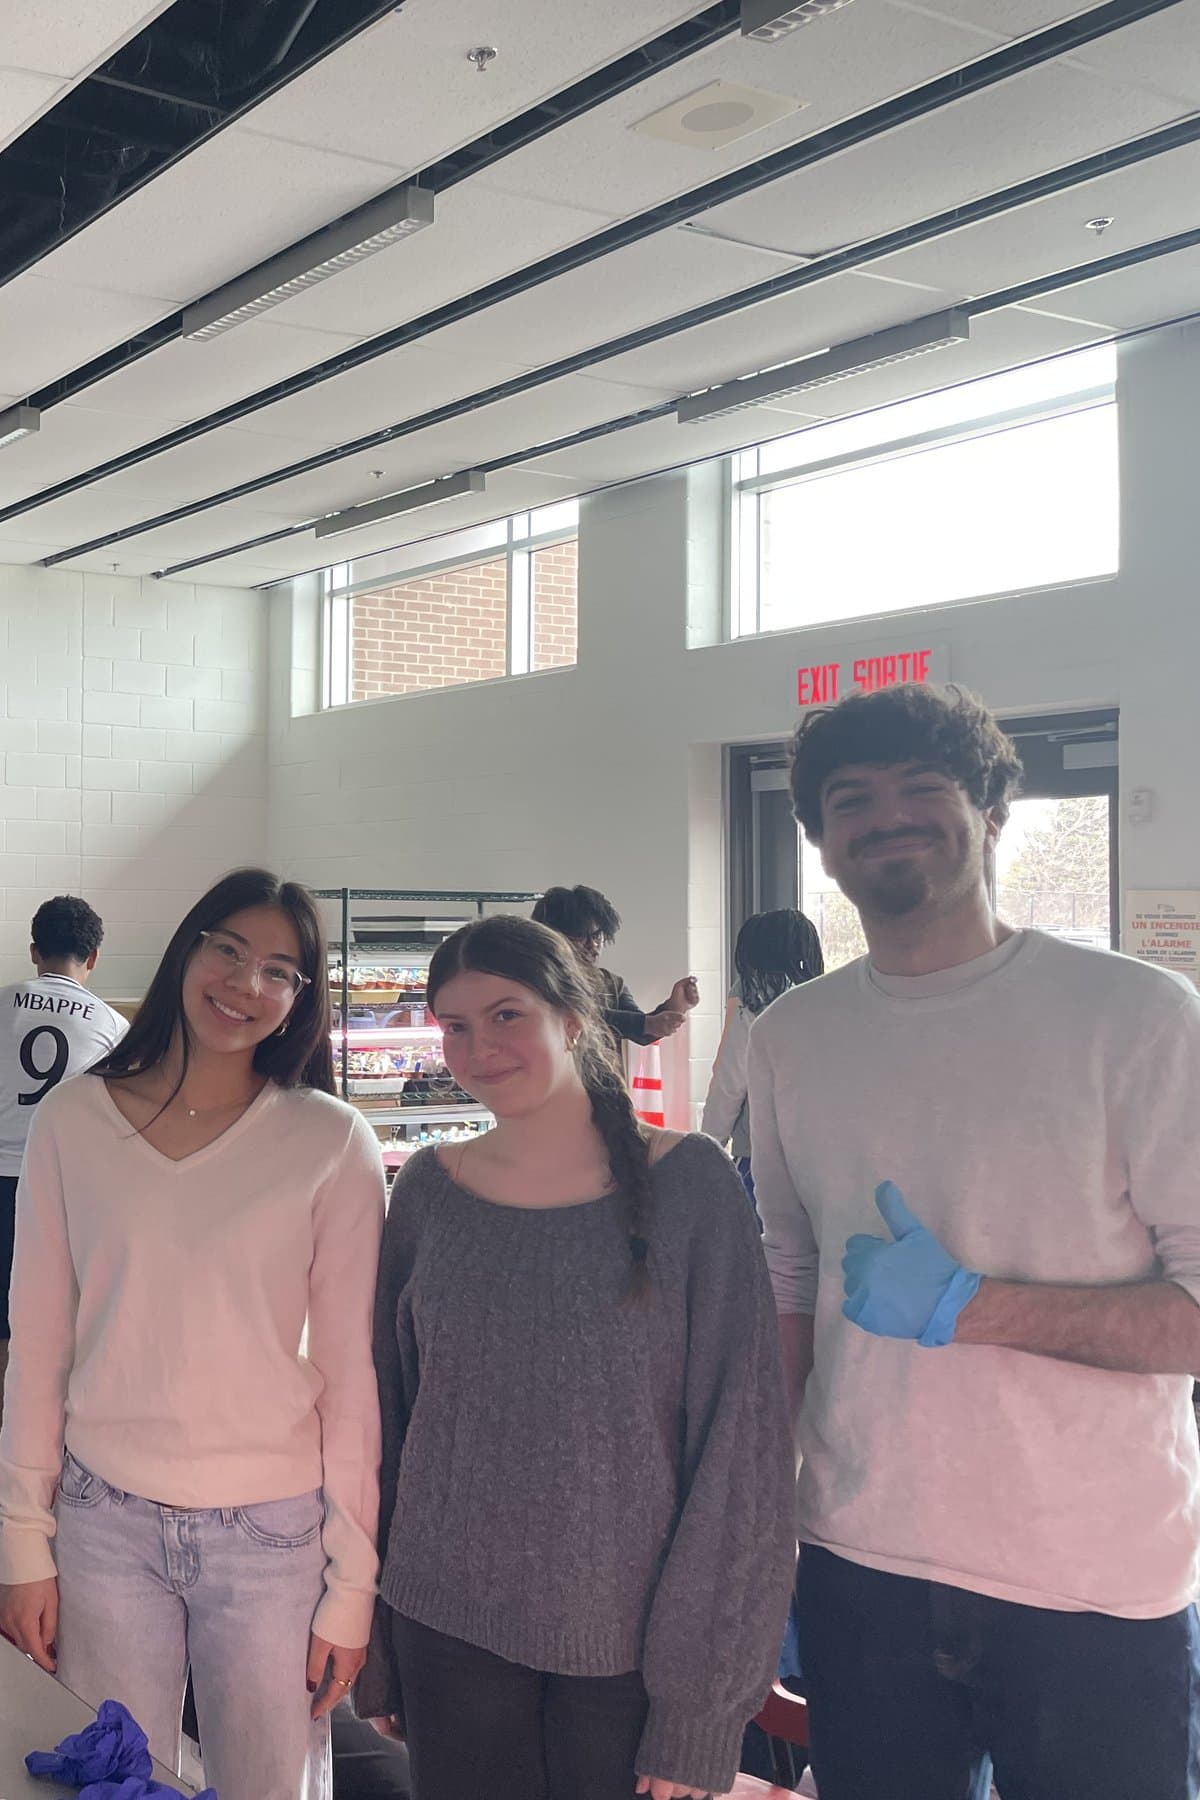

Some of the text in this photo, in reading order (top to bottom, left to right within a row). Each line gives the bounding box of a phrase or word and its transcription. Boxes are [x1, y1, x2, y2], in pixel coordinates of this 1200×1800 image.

[798, 664, 840, 706] EXIT
[1132, 921, 1200, 930] UN INCENDIE
[1141, 939, 1192, 949] L'ALARME
[13, 992, 95, 1020] MBAPPÉ
[18, 1025, 69, 1106] 9
